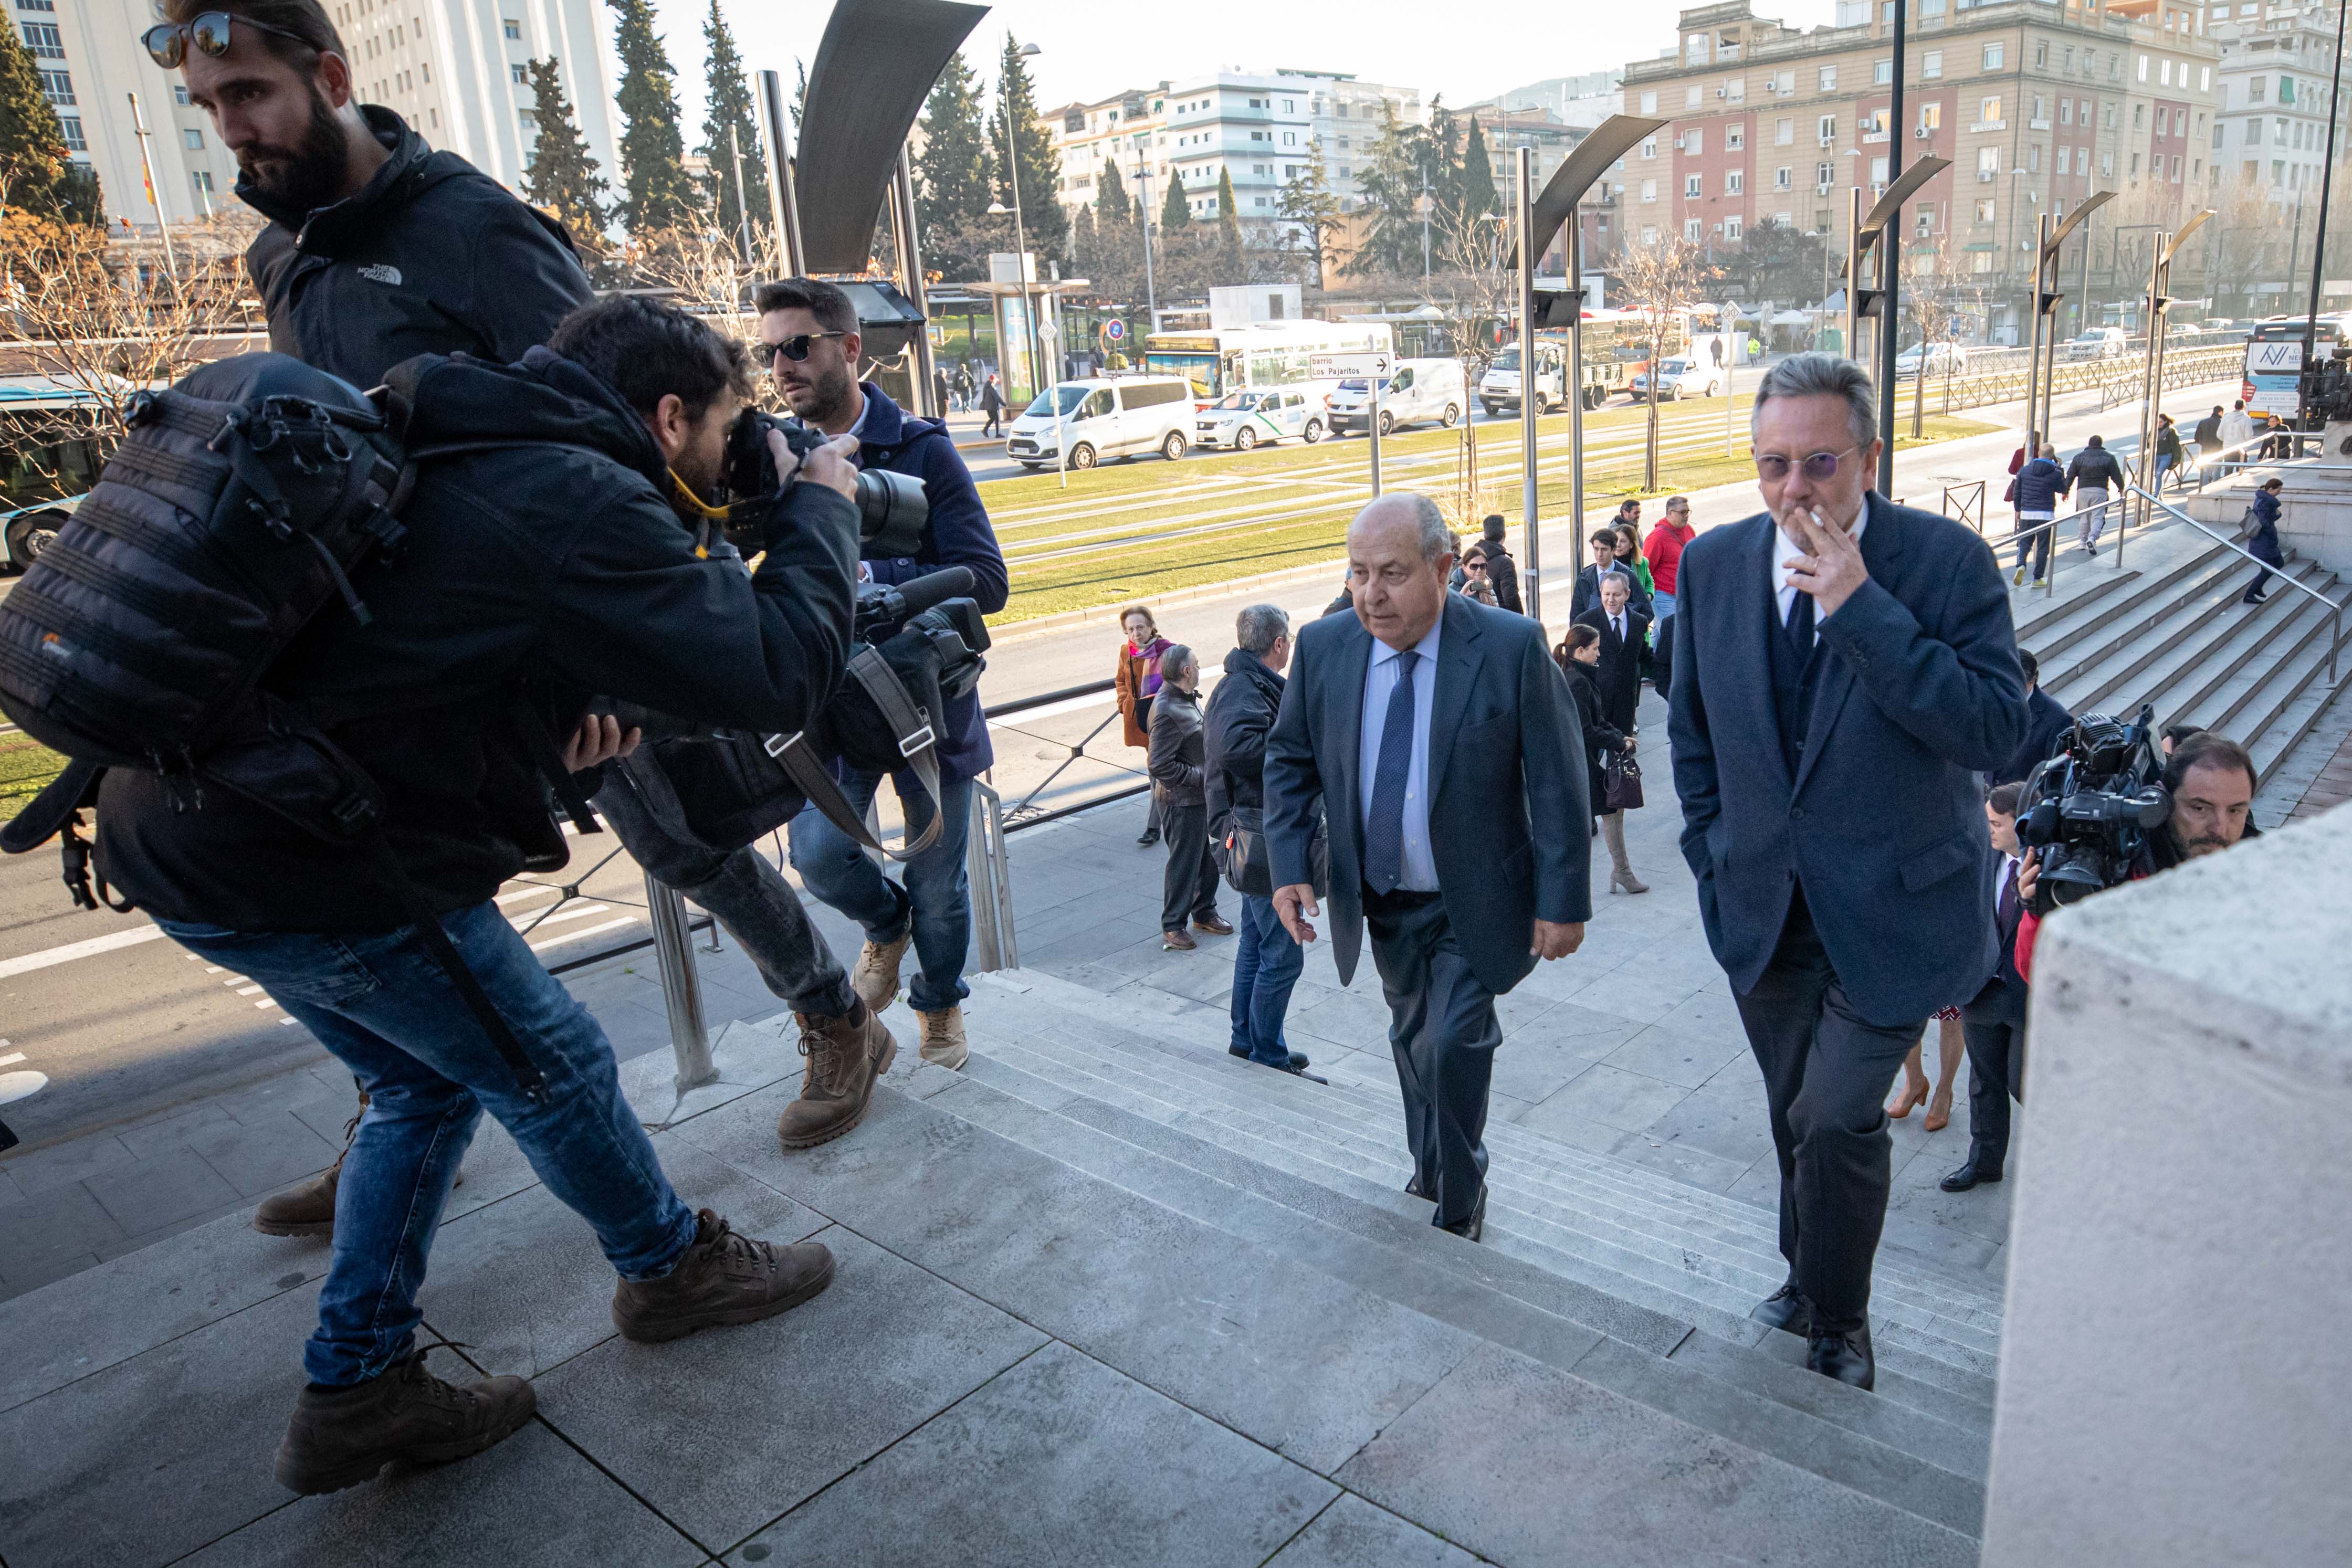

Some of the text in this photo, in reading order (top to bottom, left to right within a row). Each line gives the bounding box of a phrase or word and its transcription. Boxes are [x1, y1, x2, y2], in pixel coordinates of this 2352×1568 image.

[357, 267, 387, 277] NORTH
[363, 272, 386, 281] FACE
[1328, 367, 1360, 376] Pajaritos
